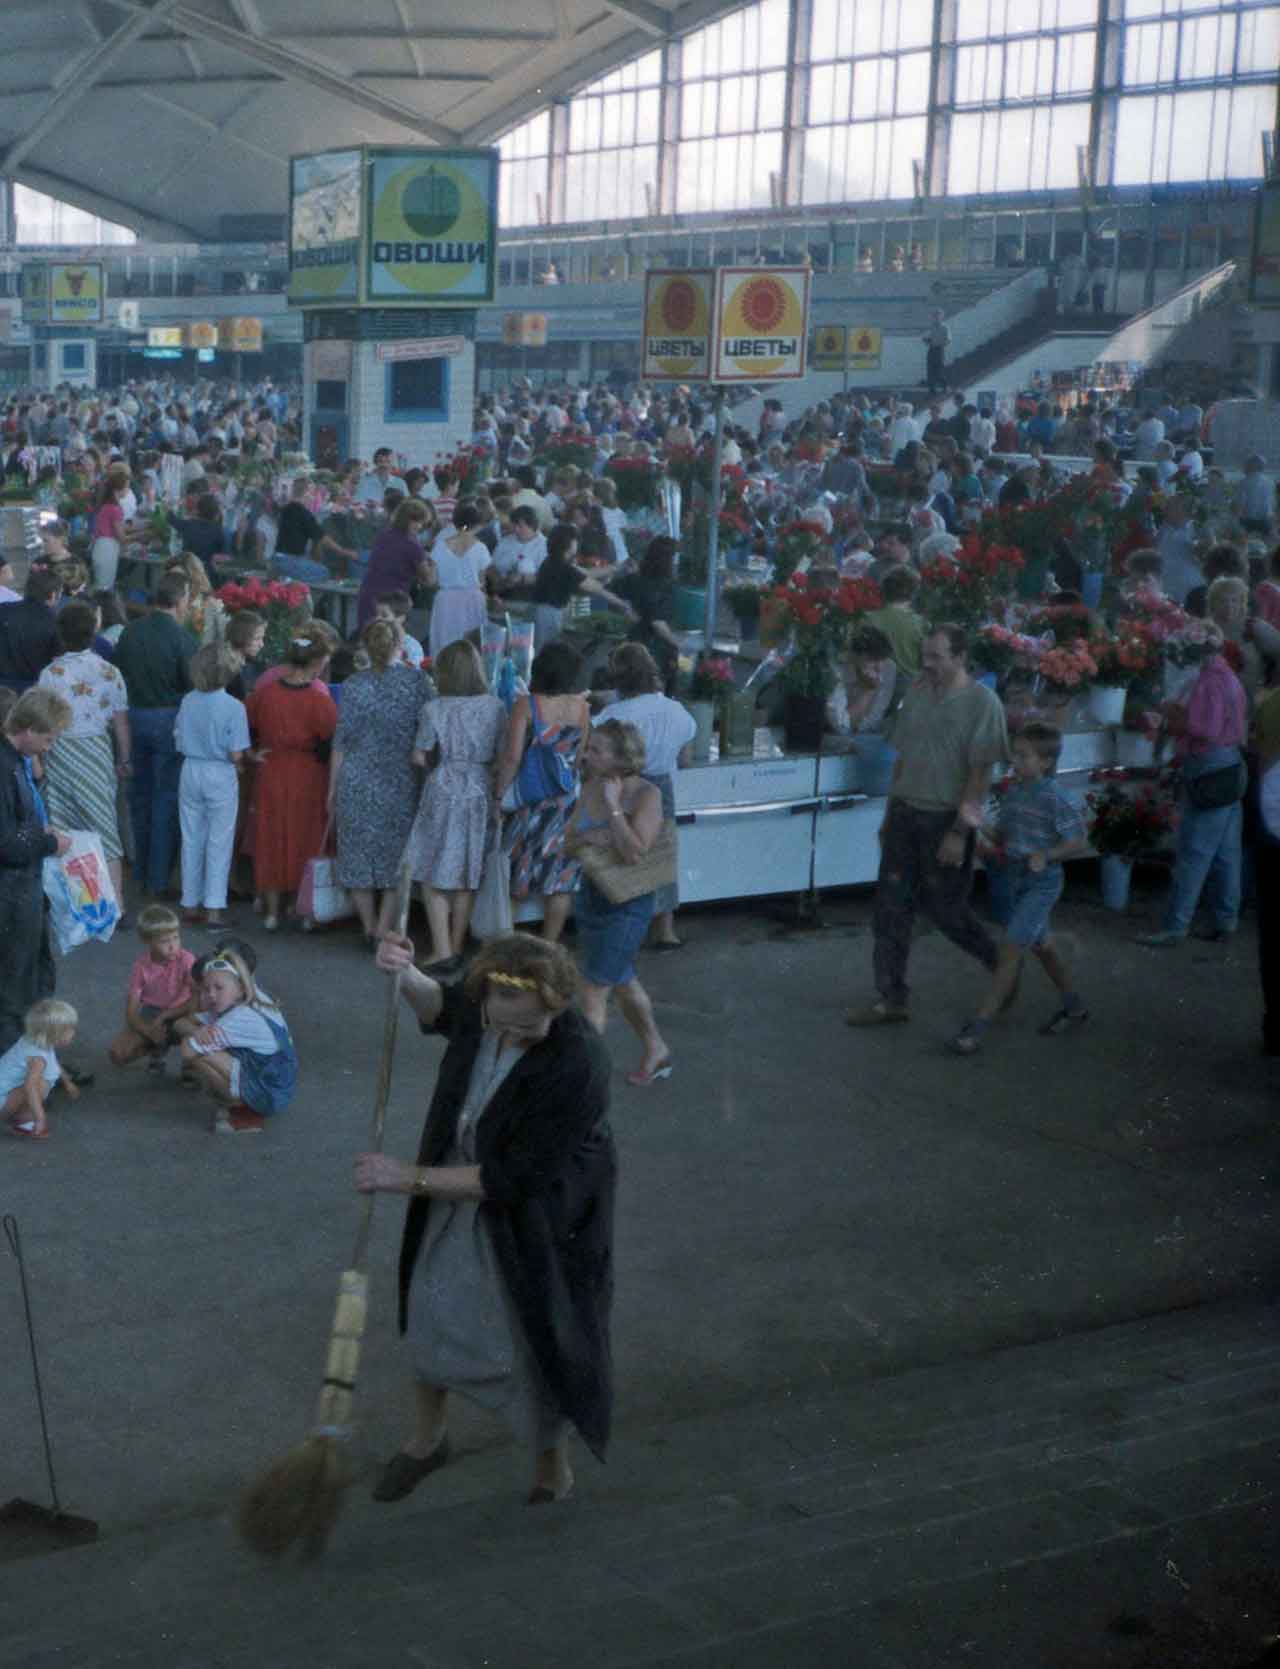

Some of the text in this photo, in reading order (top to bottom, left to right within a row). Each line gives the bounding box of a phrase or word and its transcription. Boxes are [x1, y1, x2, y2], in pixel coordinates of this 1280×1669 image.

[374, 242, 486, 264] ОВОЩИ
[648, 339, 705, 358] ЦВЕТЫ
[725, 338, 797, 357] ЦВЕТЫ
